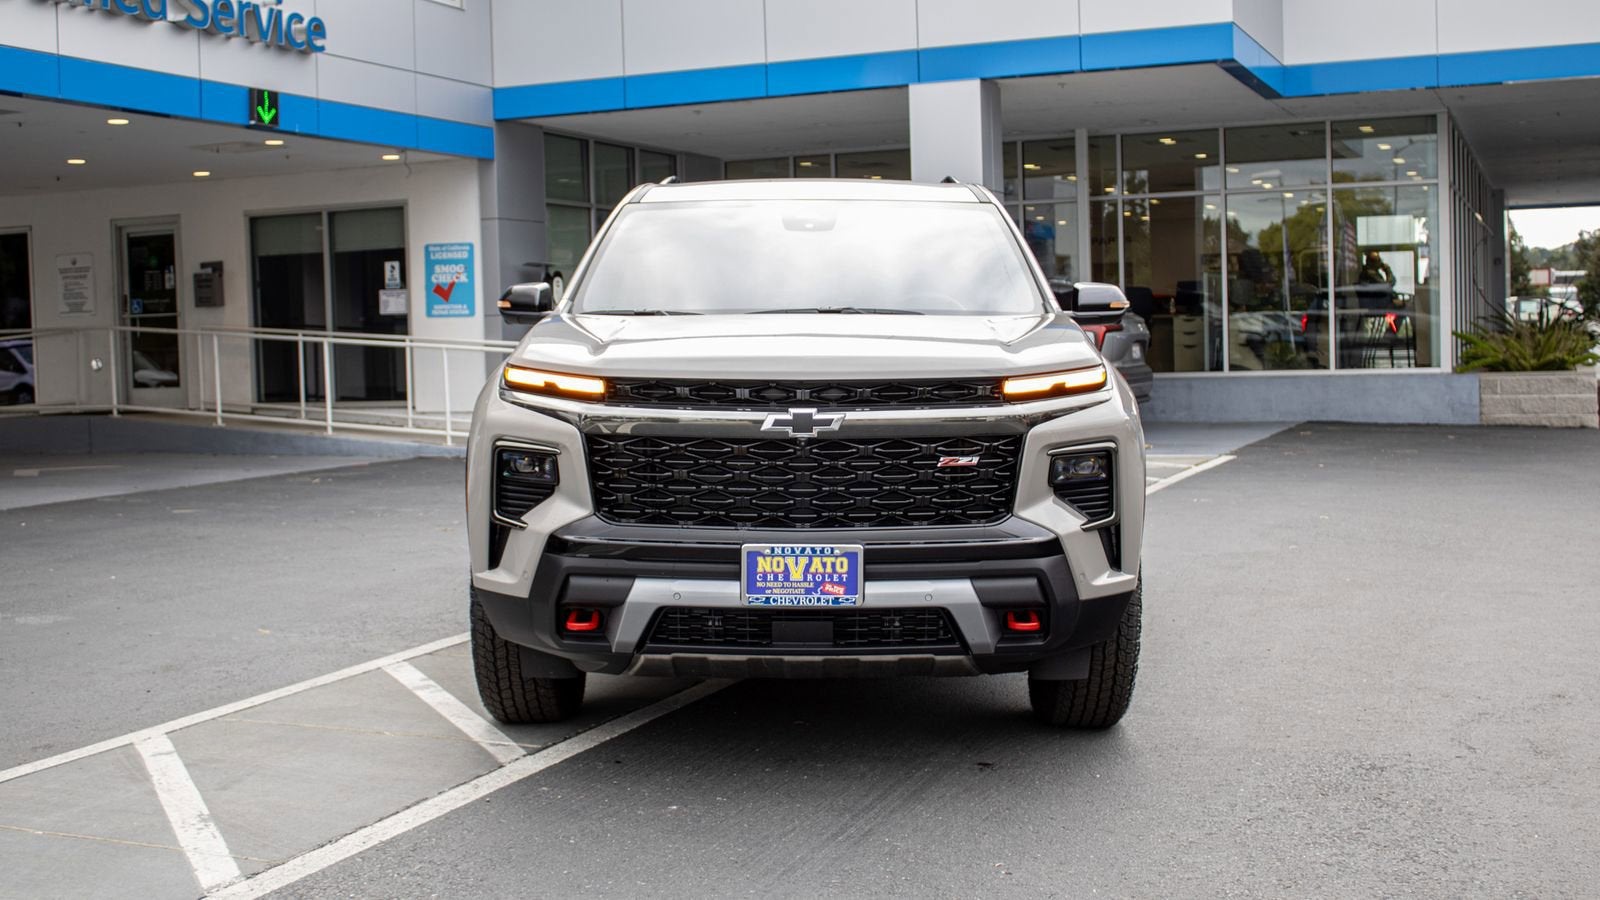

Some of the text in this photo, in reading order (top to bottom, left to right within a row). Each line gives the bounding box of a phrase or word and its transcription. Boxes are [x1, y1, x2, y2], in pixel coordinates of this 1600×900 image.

[186, 0, 327, 52] Service
[430, 252, 468, 260] LICENSED
[434, 264, 465, 273] SMOG
[431, 273, 468, 283] CHECK
[756, 556, 848, 581] NOVATO
[769, 595, 835, 606] CHEVROLET
